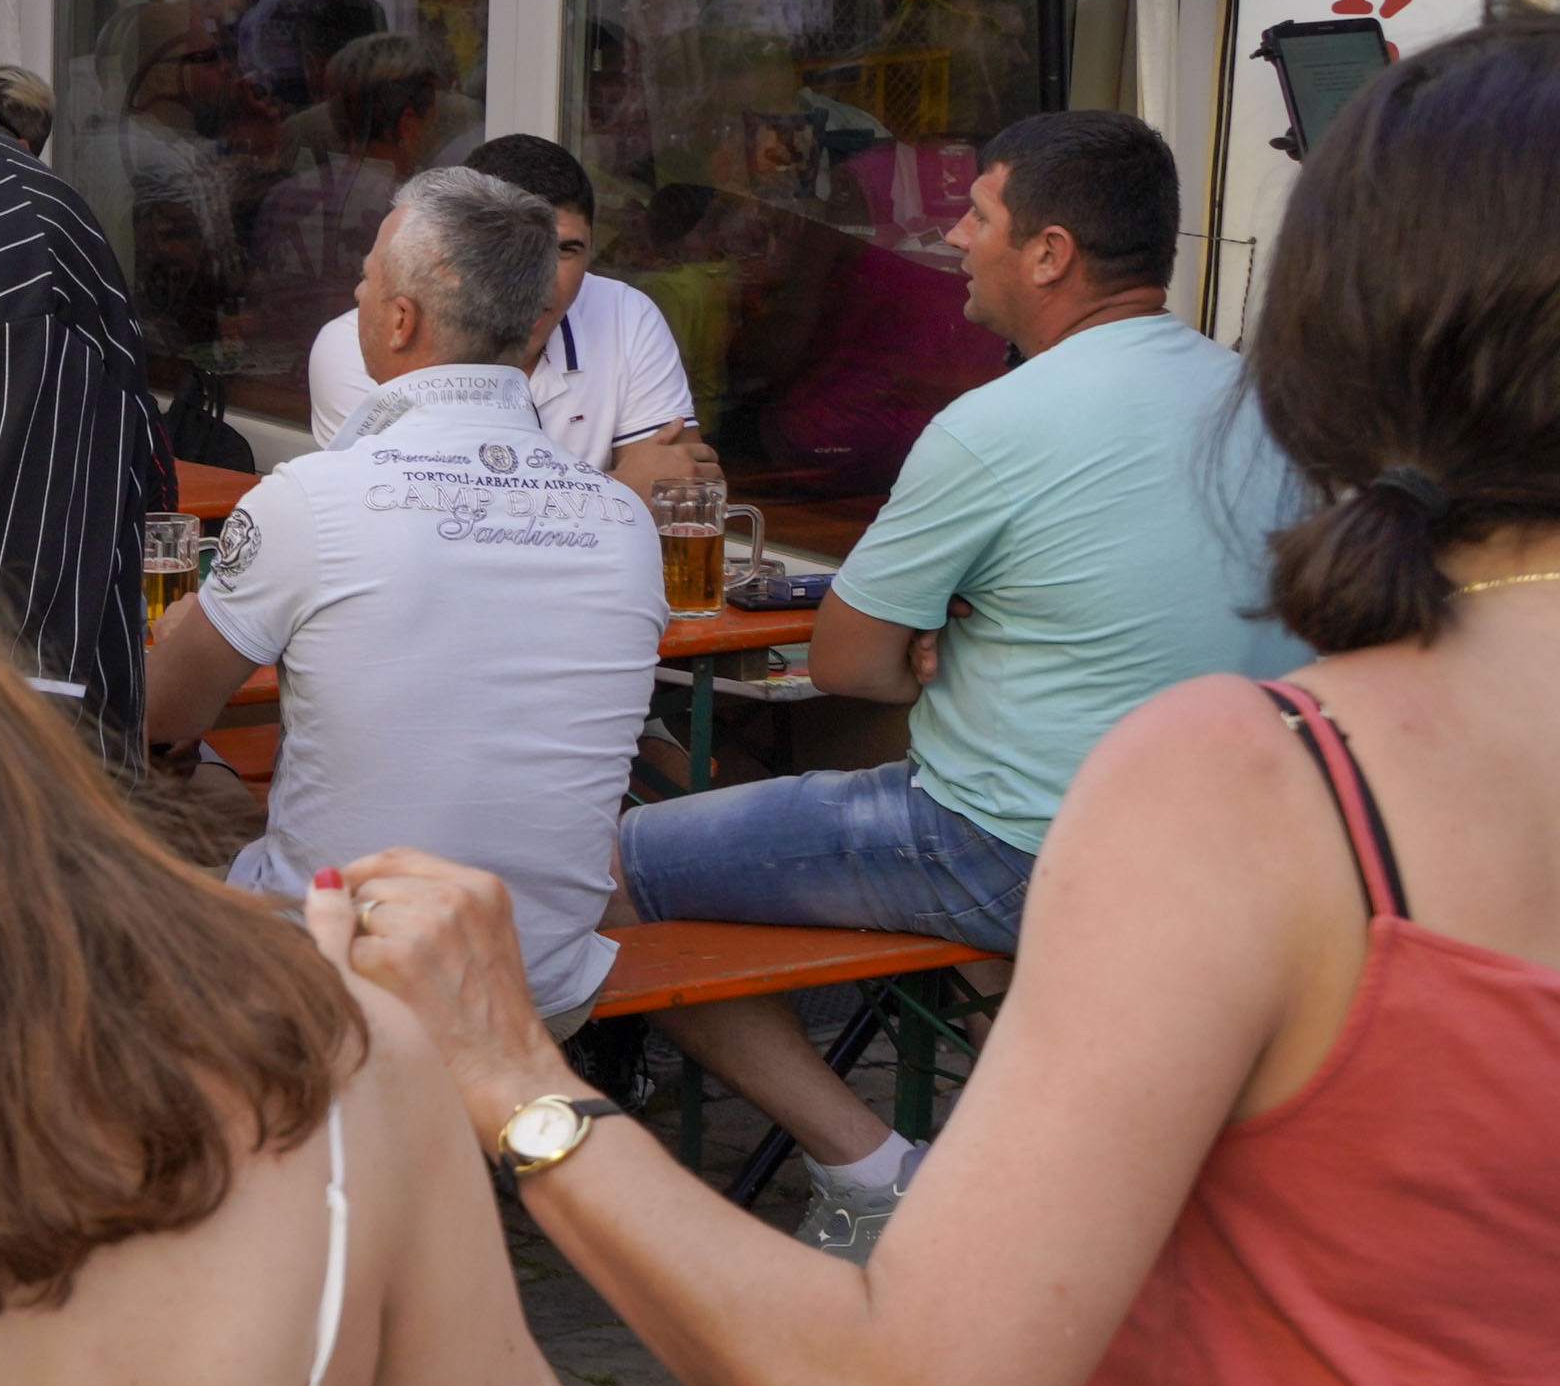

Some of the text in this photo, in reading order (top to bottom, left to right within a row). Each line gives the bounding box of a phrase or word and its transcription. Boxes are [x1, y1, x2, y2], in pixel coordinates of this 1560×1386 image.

[356, 386, 403, 437] PREMIUM
[408, 376, 499, 392] LOCATION
[363, 484, 637, 526] CAMP DAVID
[544, 480, 601, 494] AIRPORT
[437, 504, 599, 549] Sardinia
